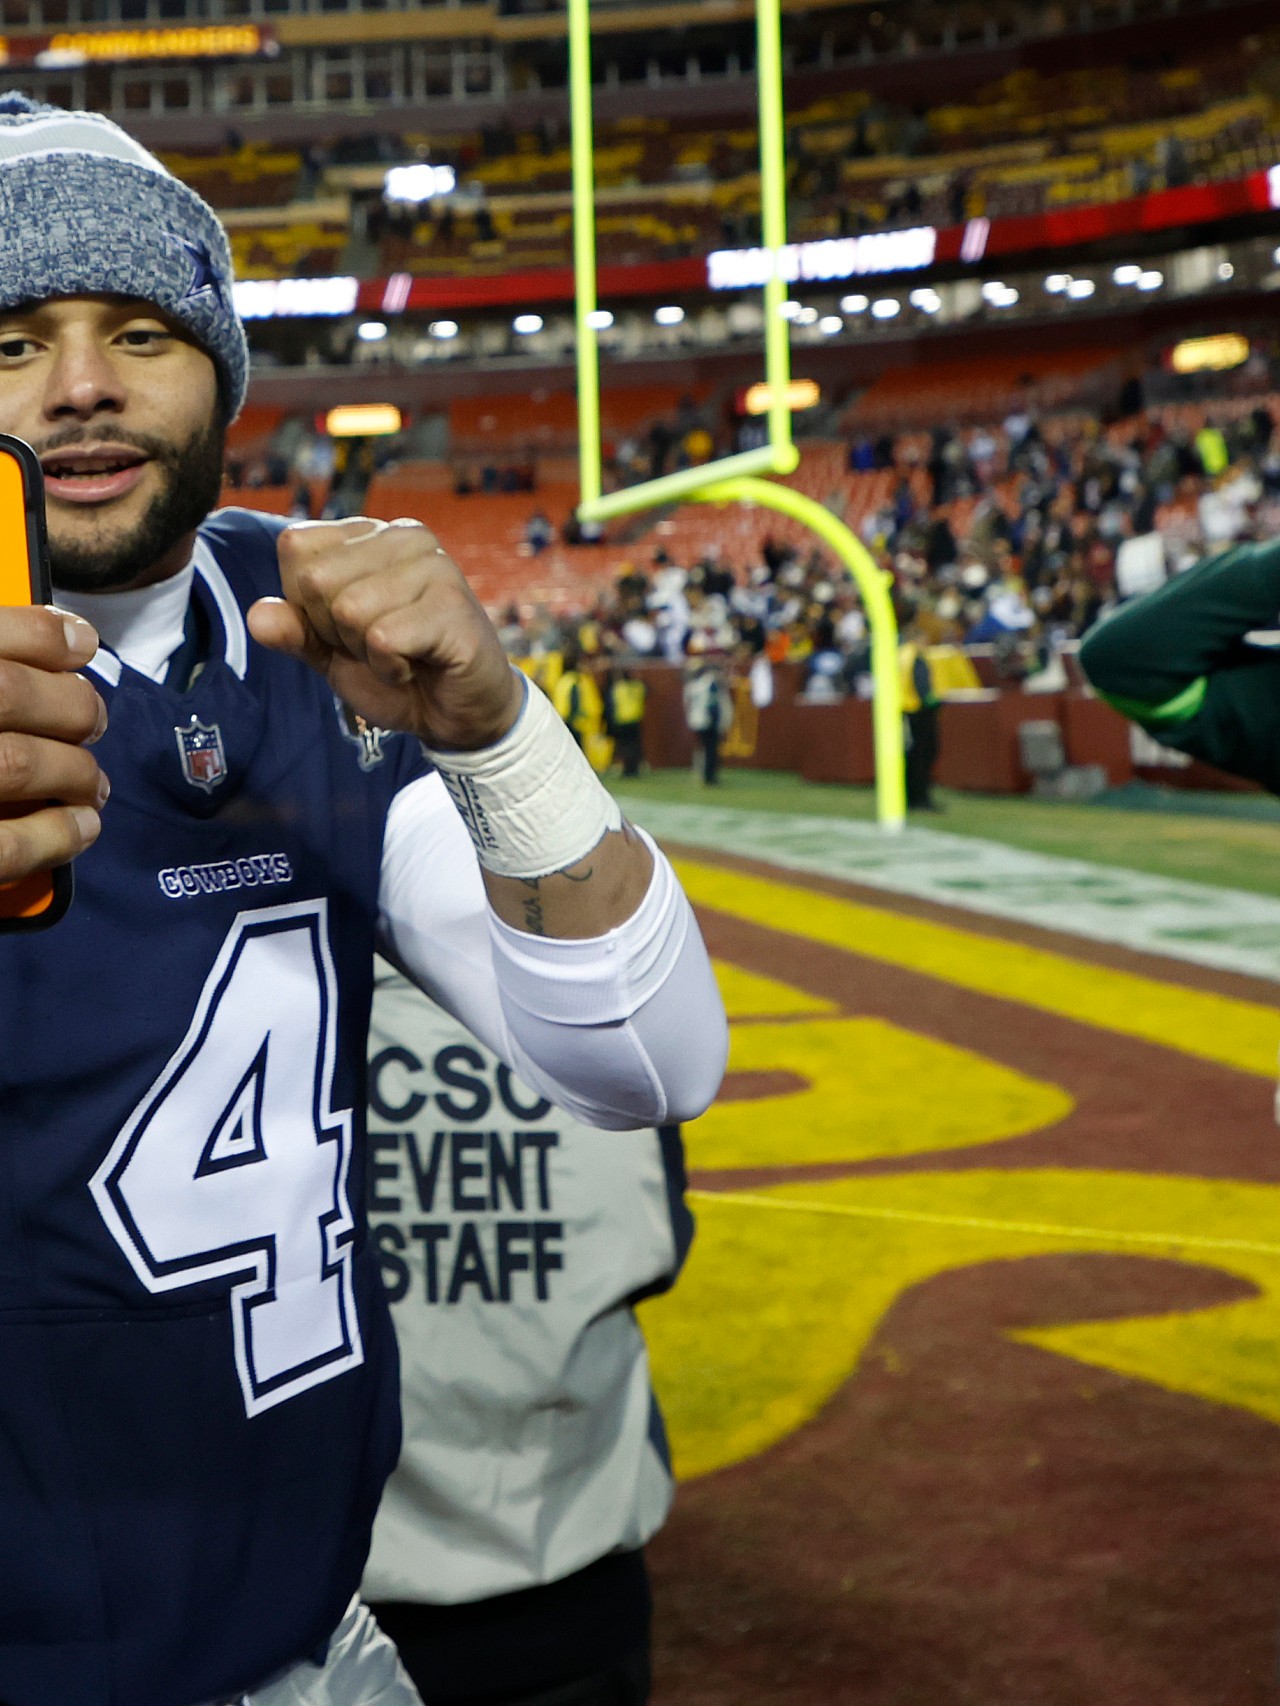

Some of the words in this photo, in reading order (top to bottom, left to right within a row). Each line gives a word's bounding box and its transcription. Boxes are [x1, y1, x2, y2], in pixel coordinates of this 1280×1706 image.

[157, 852, 294, 899] COWBOYS
[88, 897, 365, 1419] 4
[367, 1132, 559, 1212] EVENT
[372, 1222, 563, 1304] STAFF
